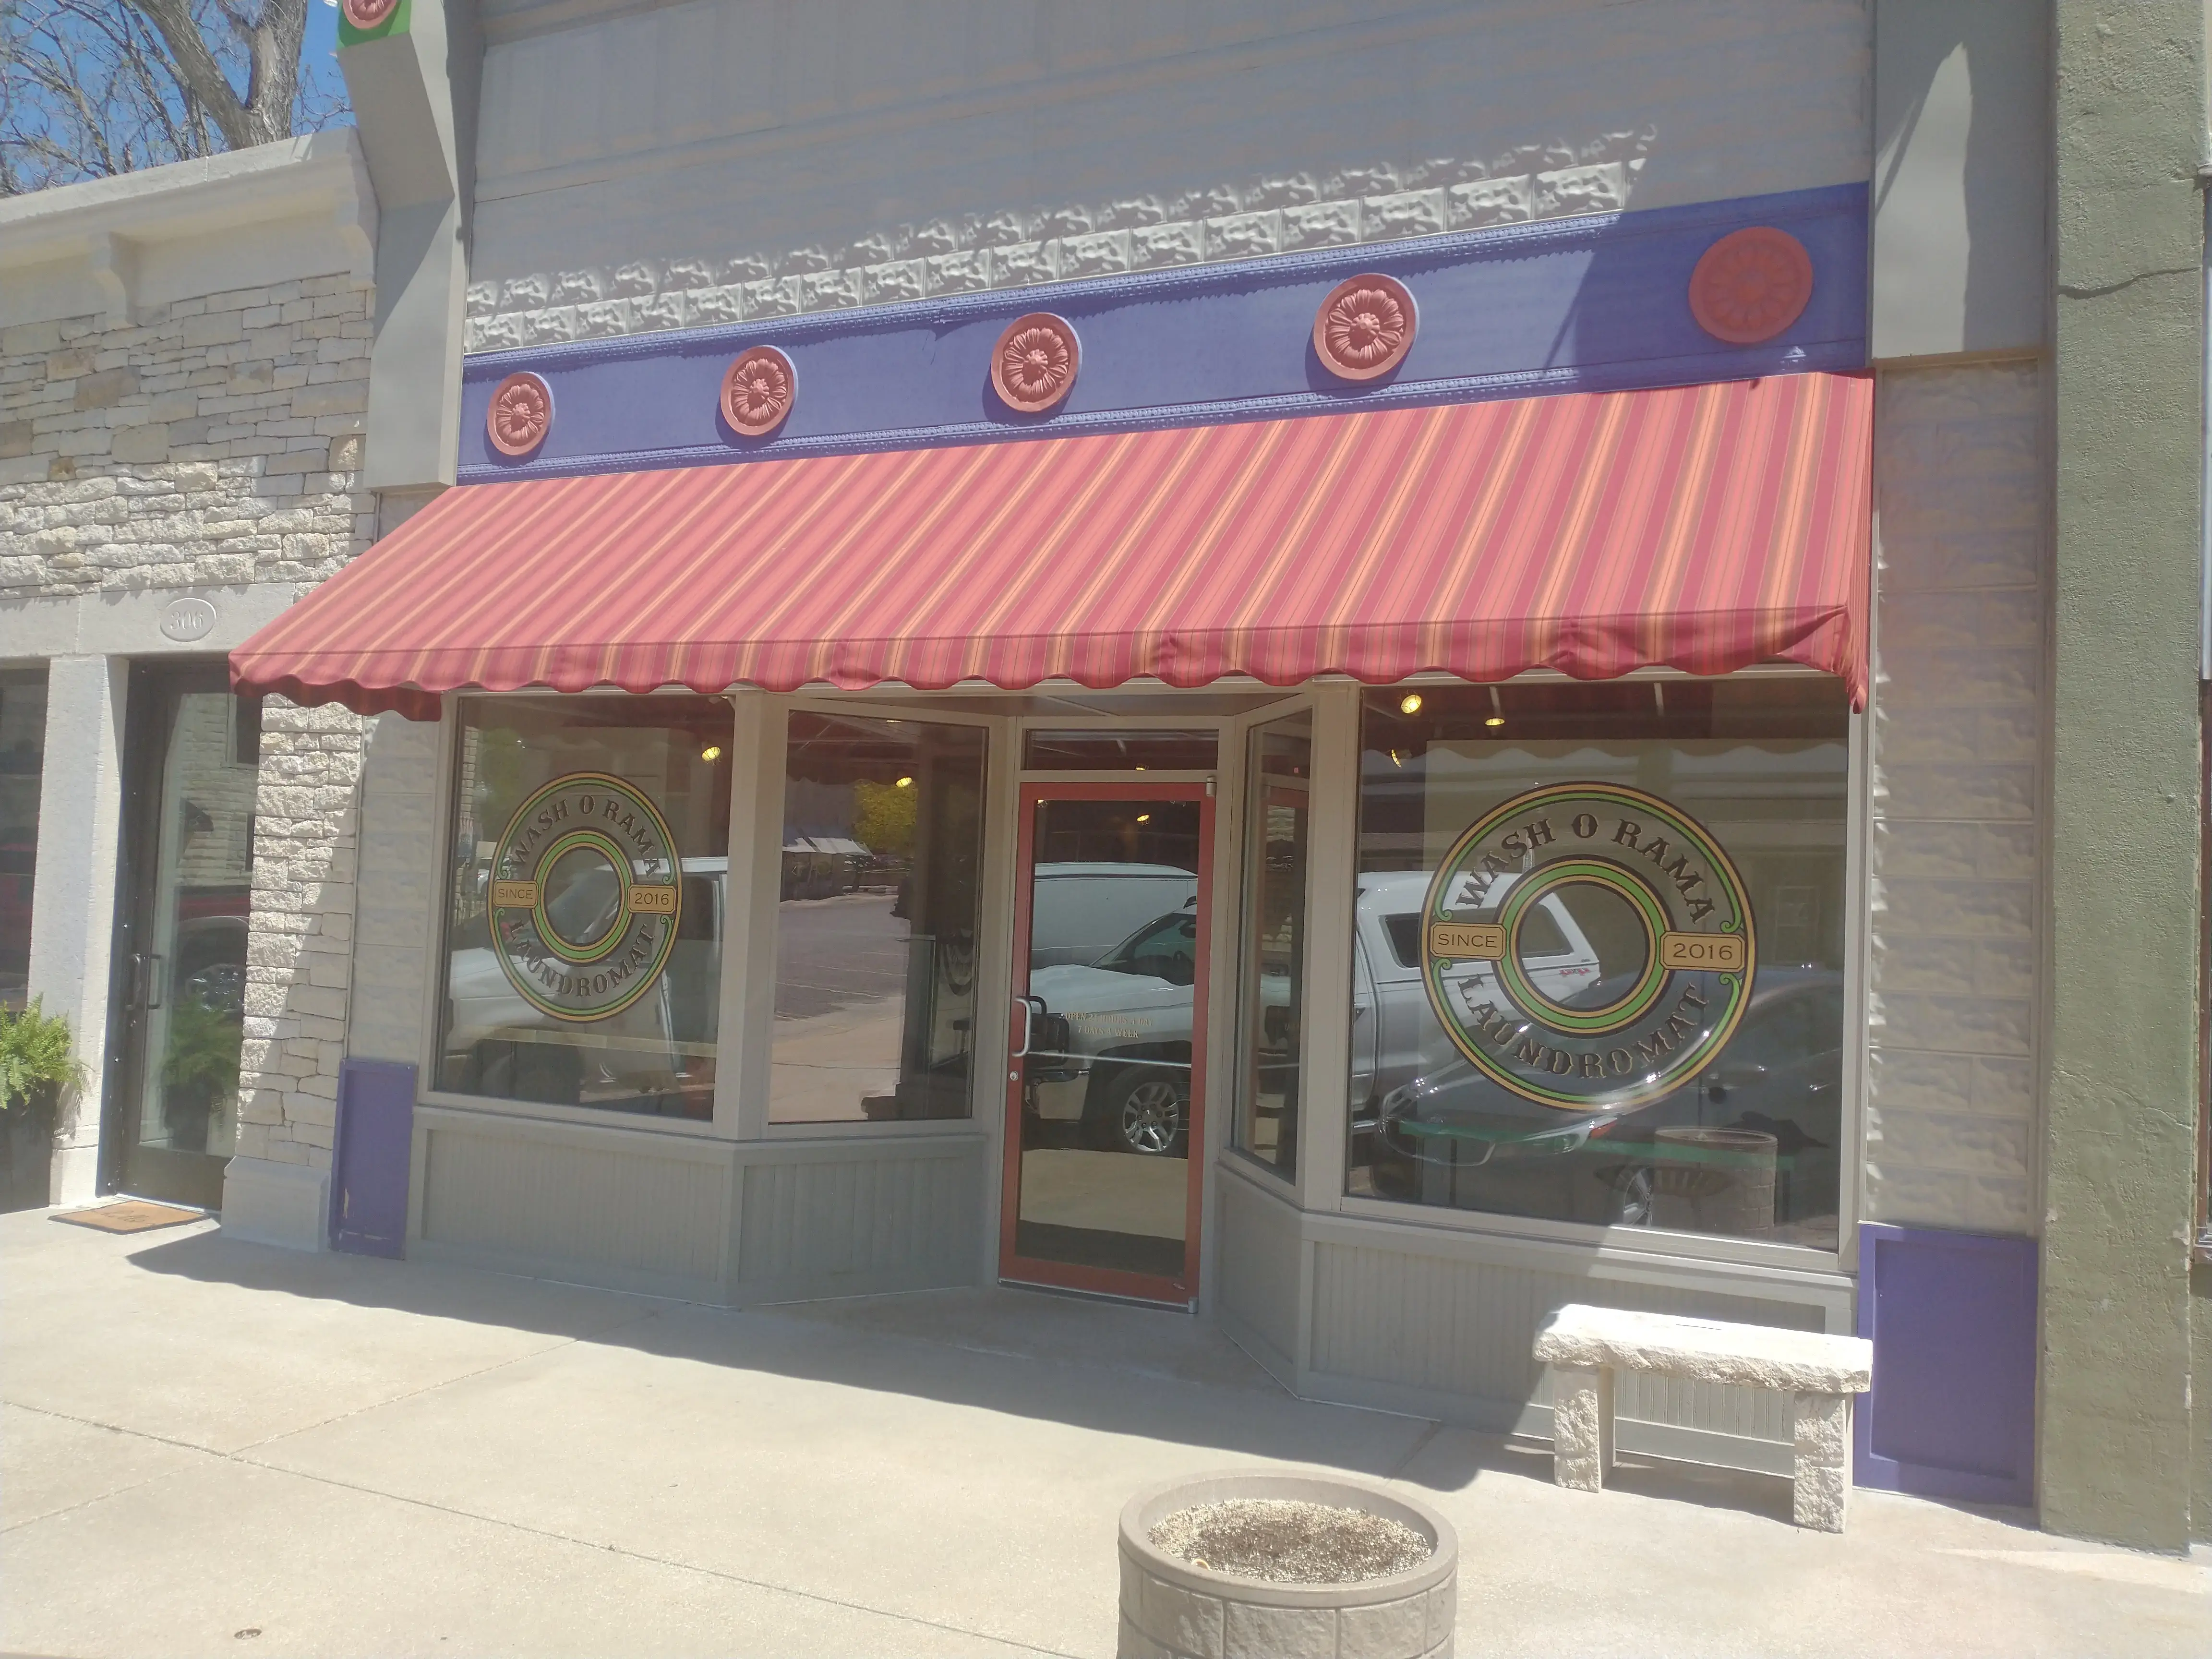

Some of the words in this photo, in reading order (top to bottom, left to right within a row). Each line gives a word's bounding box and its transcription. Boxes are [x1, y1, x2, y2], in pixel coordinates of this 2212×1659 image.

[170, 611, 203, 630] 306
[512, 798, 570, 866] WASH
[579, 794, 595, 815] O
[601, 798, 661, 878] RAMA
[1455, 817, 1557, 909] WASH
[1571, 813, 1599, 839] O
[1611, 818, 1716, 925] RAMA
[498, 888, 533, 900] SINCE
[634, 892, 670, 906] 2016
[1437, 933, 1498, 949] SINCE
[509, 919, 656, 997] LAUNDROMAT
[1672, 943, 1733, 961] 2016
[1066, 1012, 1086, 1021] OPEN
[1100, 1014, 1128, 1024] HOURS
[1138, 1018, 1154, 1026] DAY
[1457, 973, 1710, 1079] LAUNDROMAT
[1078, 1025, 1083, 1034] 7
[1084, 1025, 1105, 1035] DAYS
[1115, 1028, 1140, 1039] WEEK
